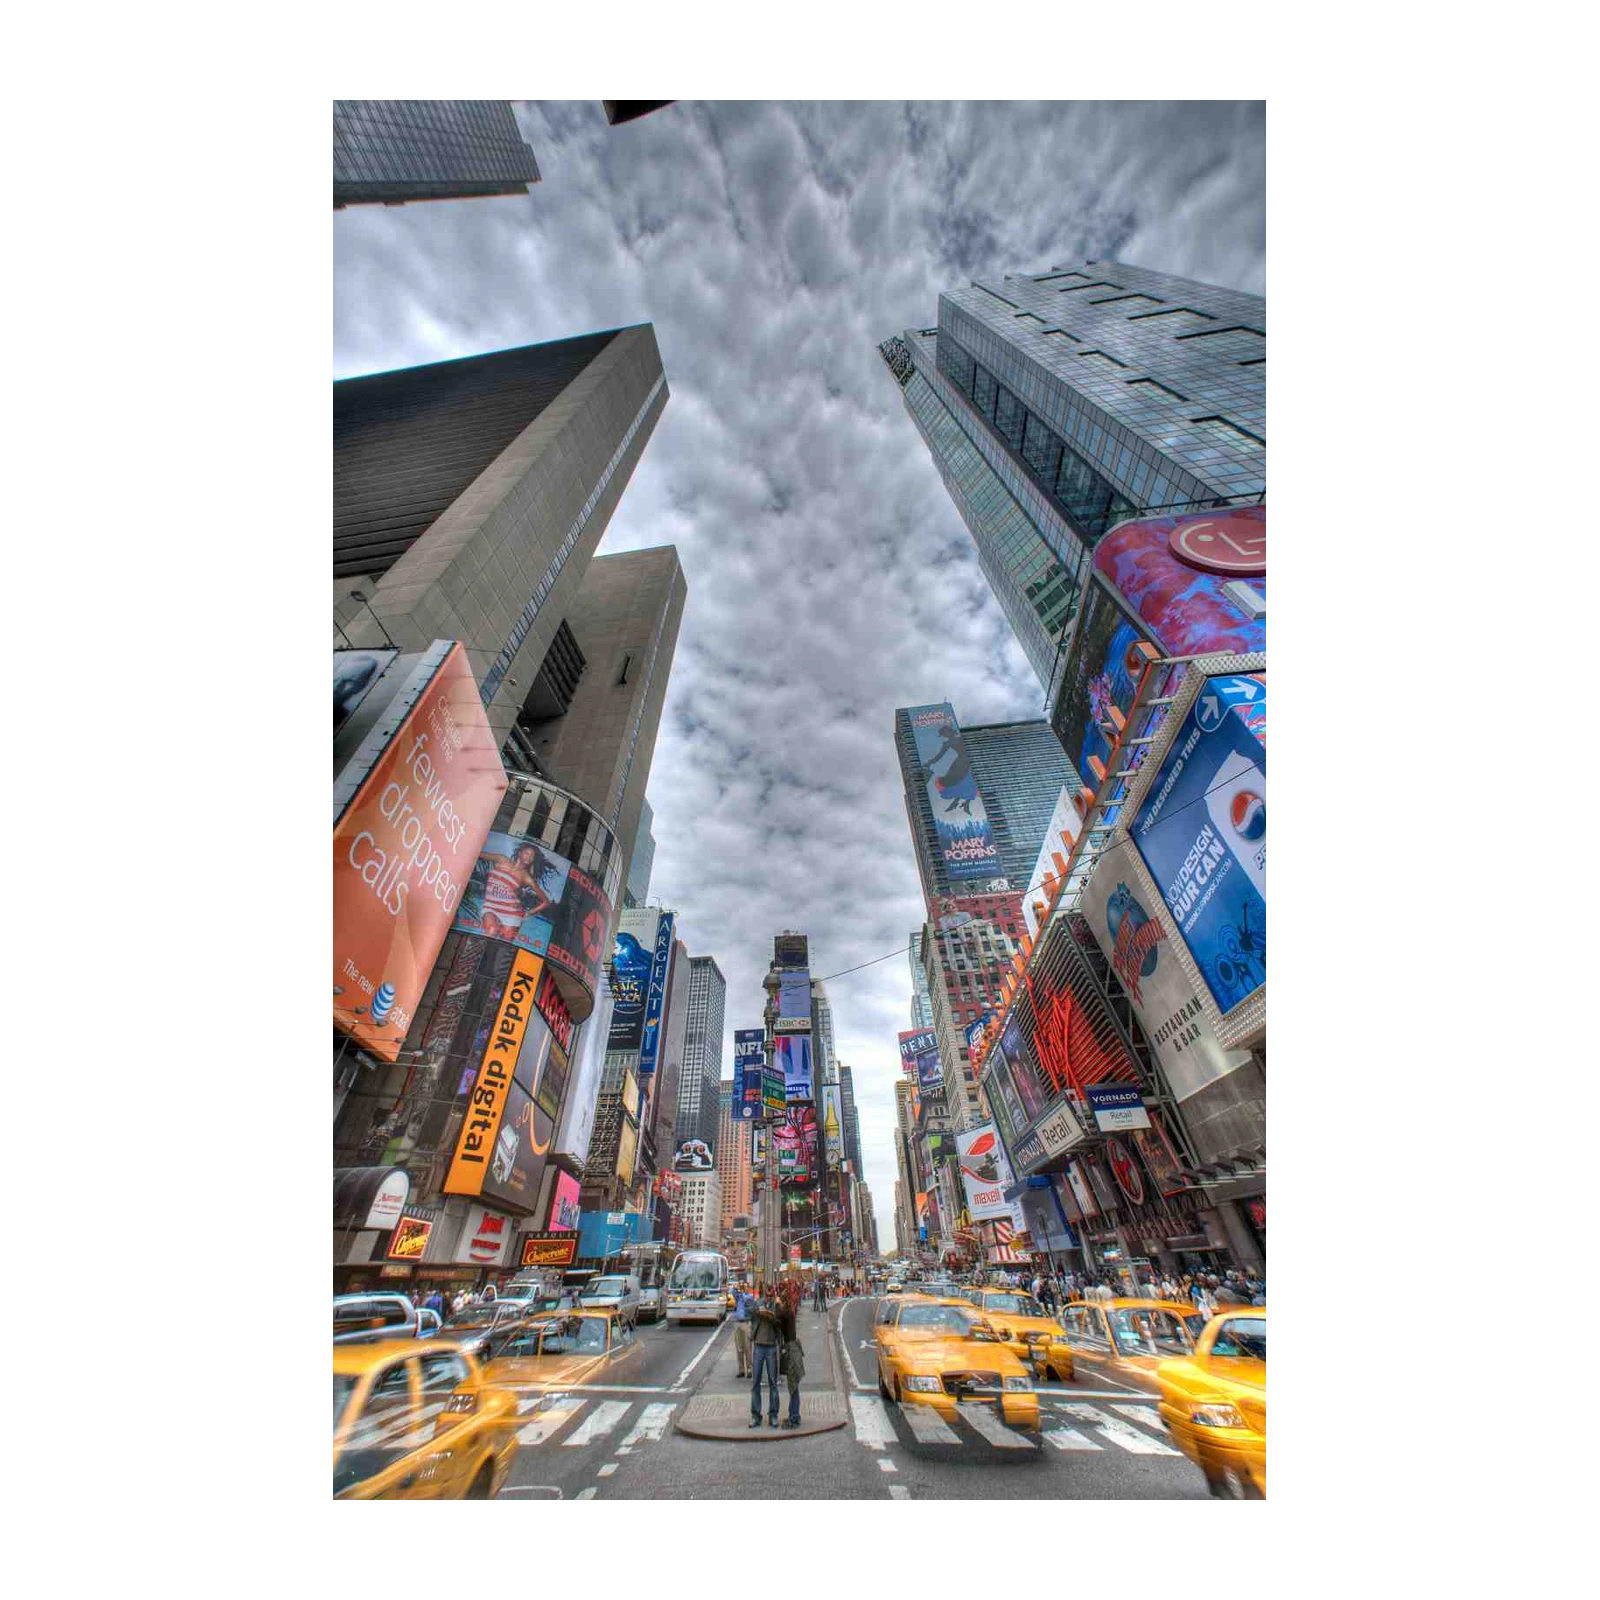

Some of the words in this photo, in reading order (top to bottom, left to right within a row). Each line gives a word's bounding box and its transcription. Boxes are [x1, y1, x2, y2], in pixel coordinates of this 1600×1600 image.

[1151, 759, 1183, 814] DESIGNED
[1181, 728, 1201, 760] THIS
[406, 733, 467, 854] fewest
[379, 782, 461, 913] dropped
[944, 844, 997, 860] POPPINS
[951, 836, 985, 850] MARY
[1179, 824, 1215, 881] DESIGN
[1172, 880, 1200, 922] OUR
[1195, 838, 1225, 885] CAN
[342, 957, 359, 982] The
[357, 974, 376, 995] new
[649, 920, 670, 1011] ARGENT
[495, 970, 534, 1054] Kodak
[1154, 996, 1202, 1045] RESTAURAN
[735, 1040, 763, 1056] NFL
[900, 1033, 934, 1055] RENT
[1173, 1039, 1182, 1052] &
[1180, 1023, 1201, 1046] BAR
[460, 1060, 507, 1165] digital
[1091, 1092, 1138, 1103] VORNADO
[1042, 1113, 1072, 1148] Retail
[973, 1188, 1001, 1205] maxell
